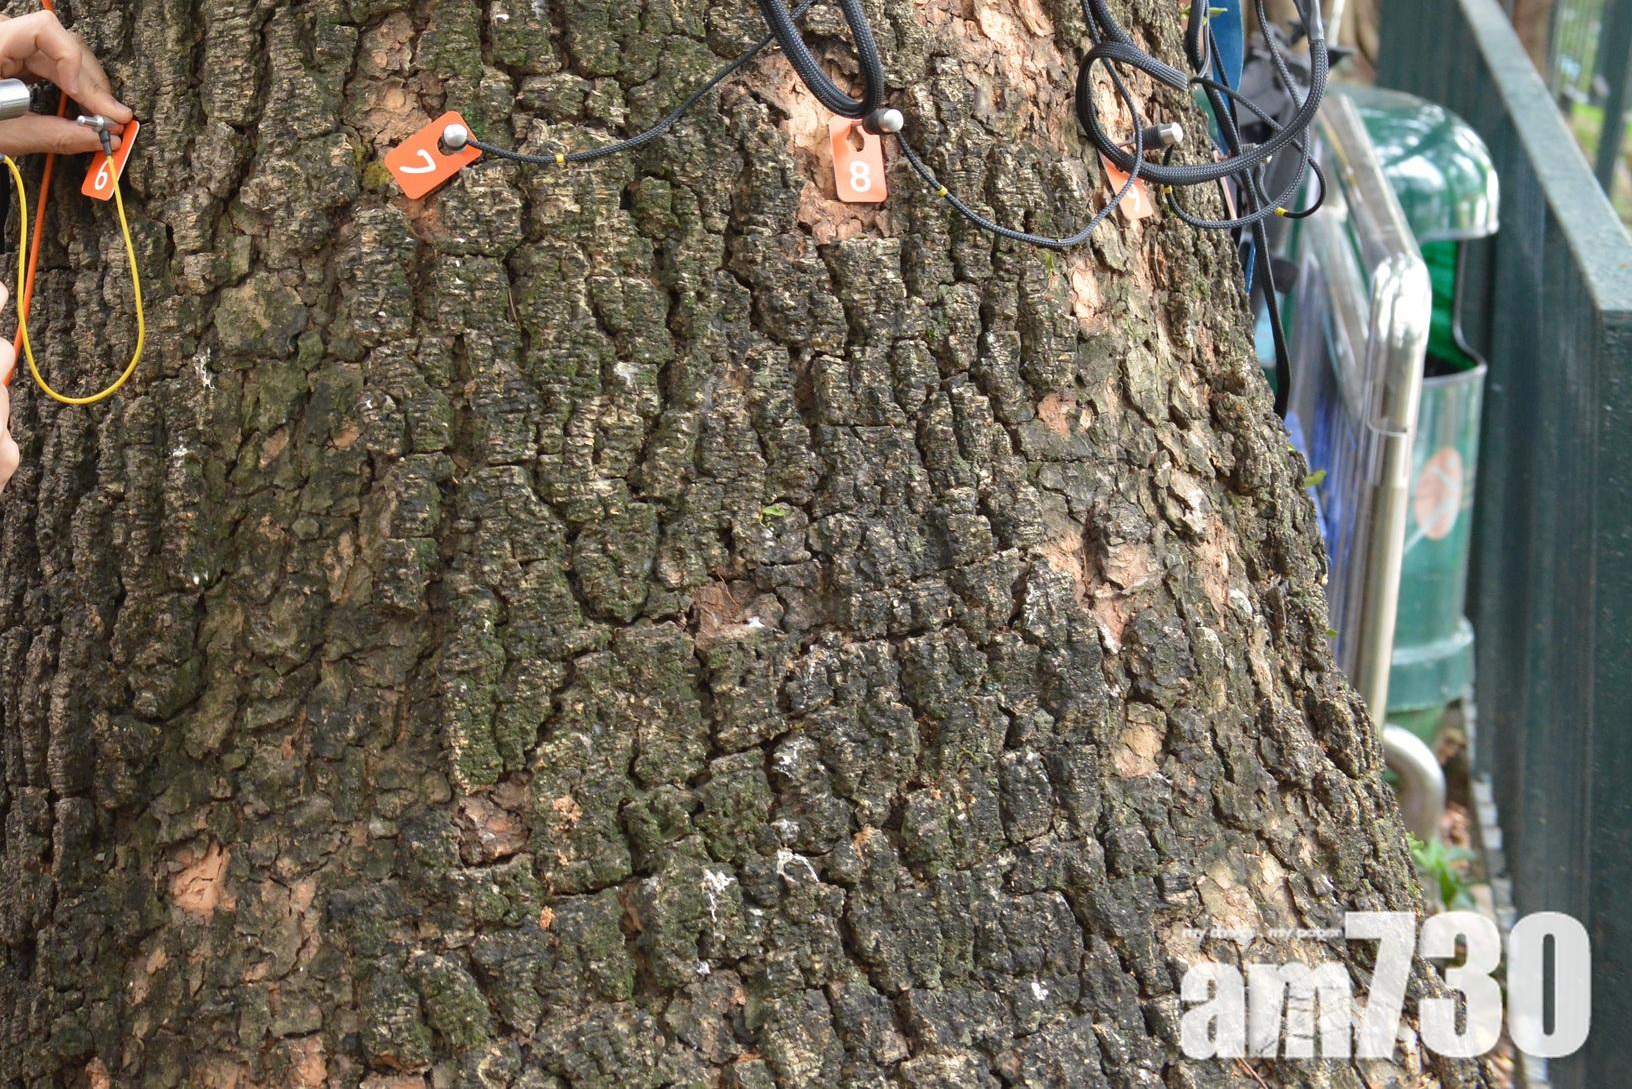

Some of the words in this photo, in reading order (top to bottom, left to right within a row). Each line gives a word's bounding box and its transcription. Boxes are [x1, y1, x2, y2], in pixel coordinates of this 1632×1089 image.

[94, 160, 109, 191] 6
[399, 148, 437, 174] 7
[849, 160, 872, 192] 8
